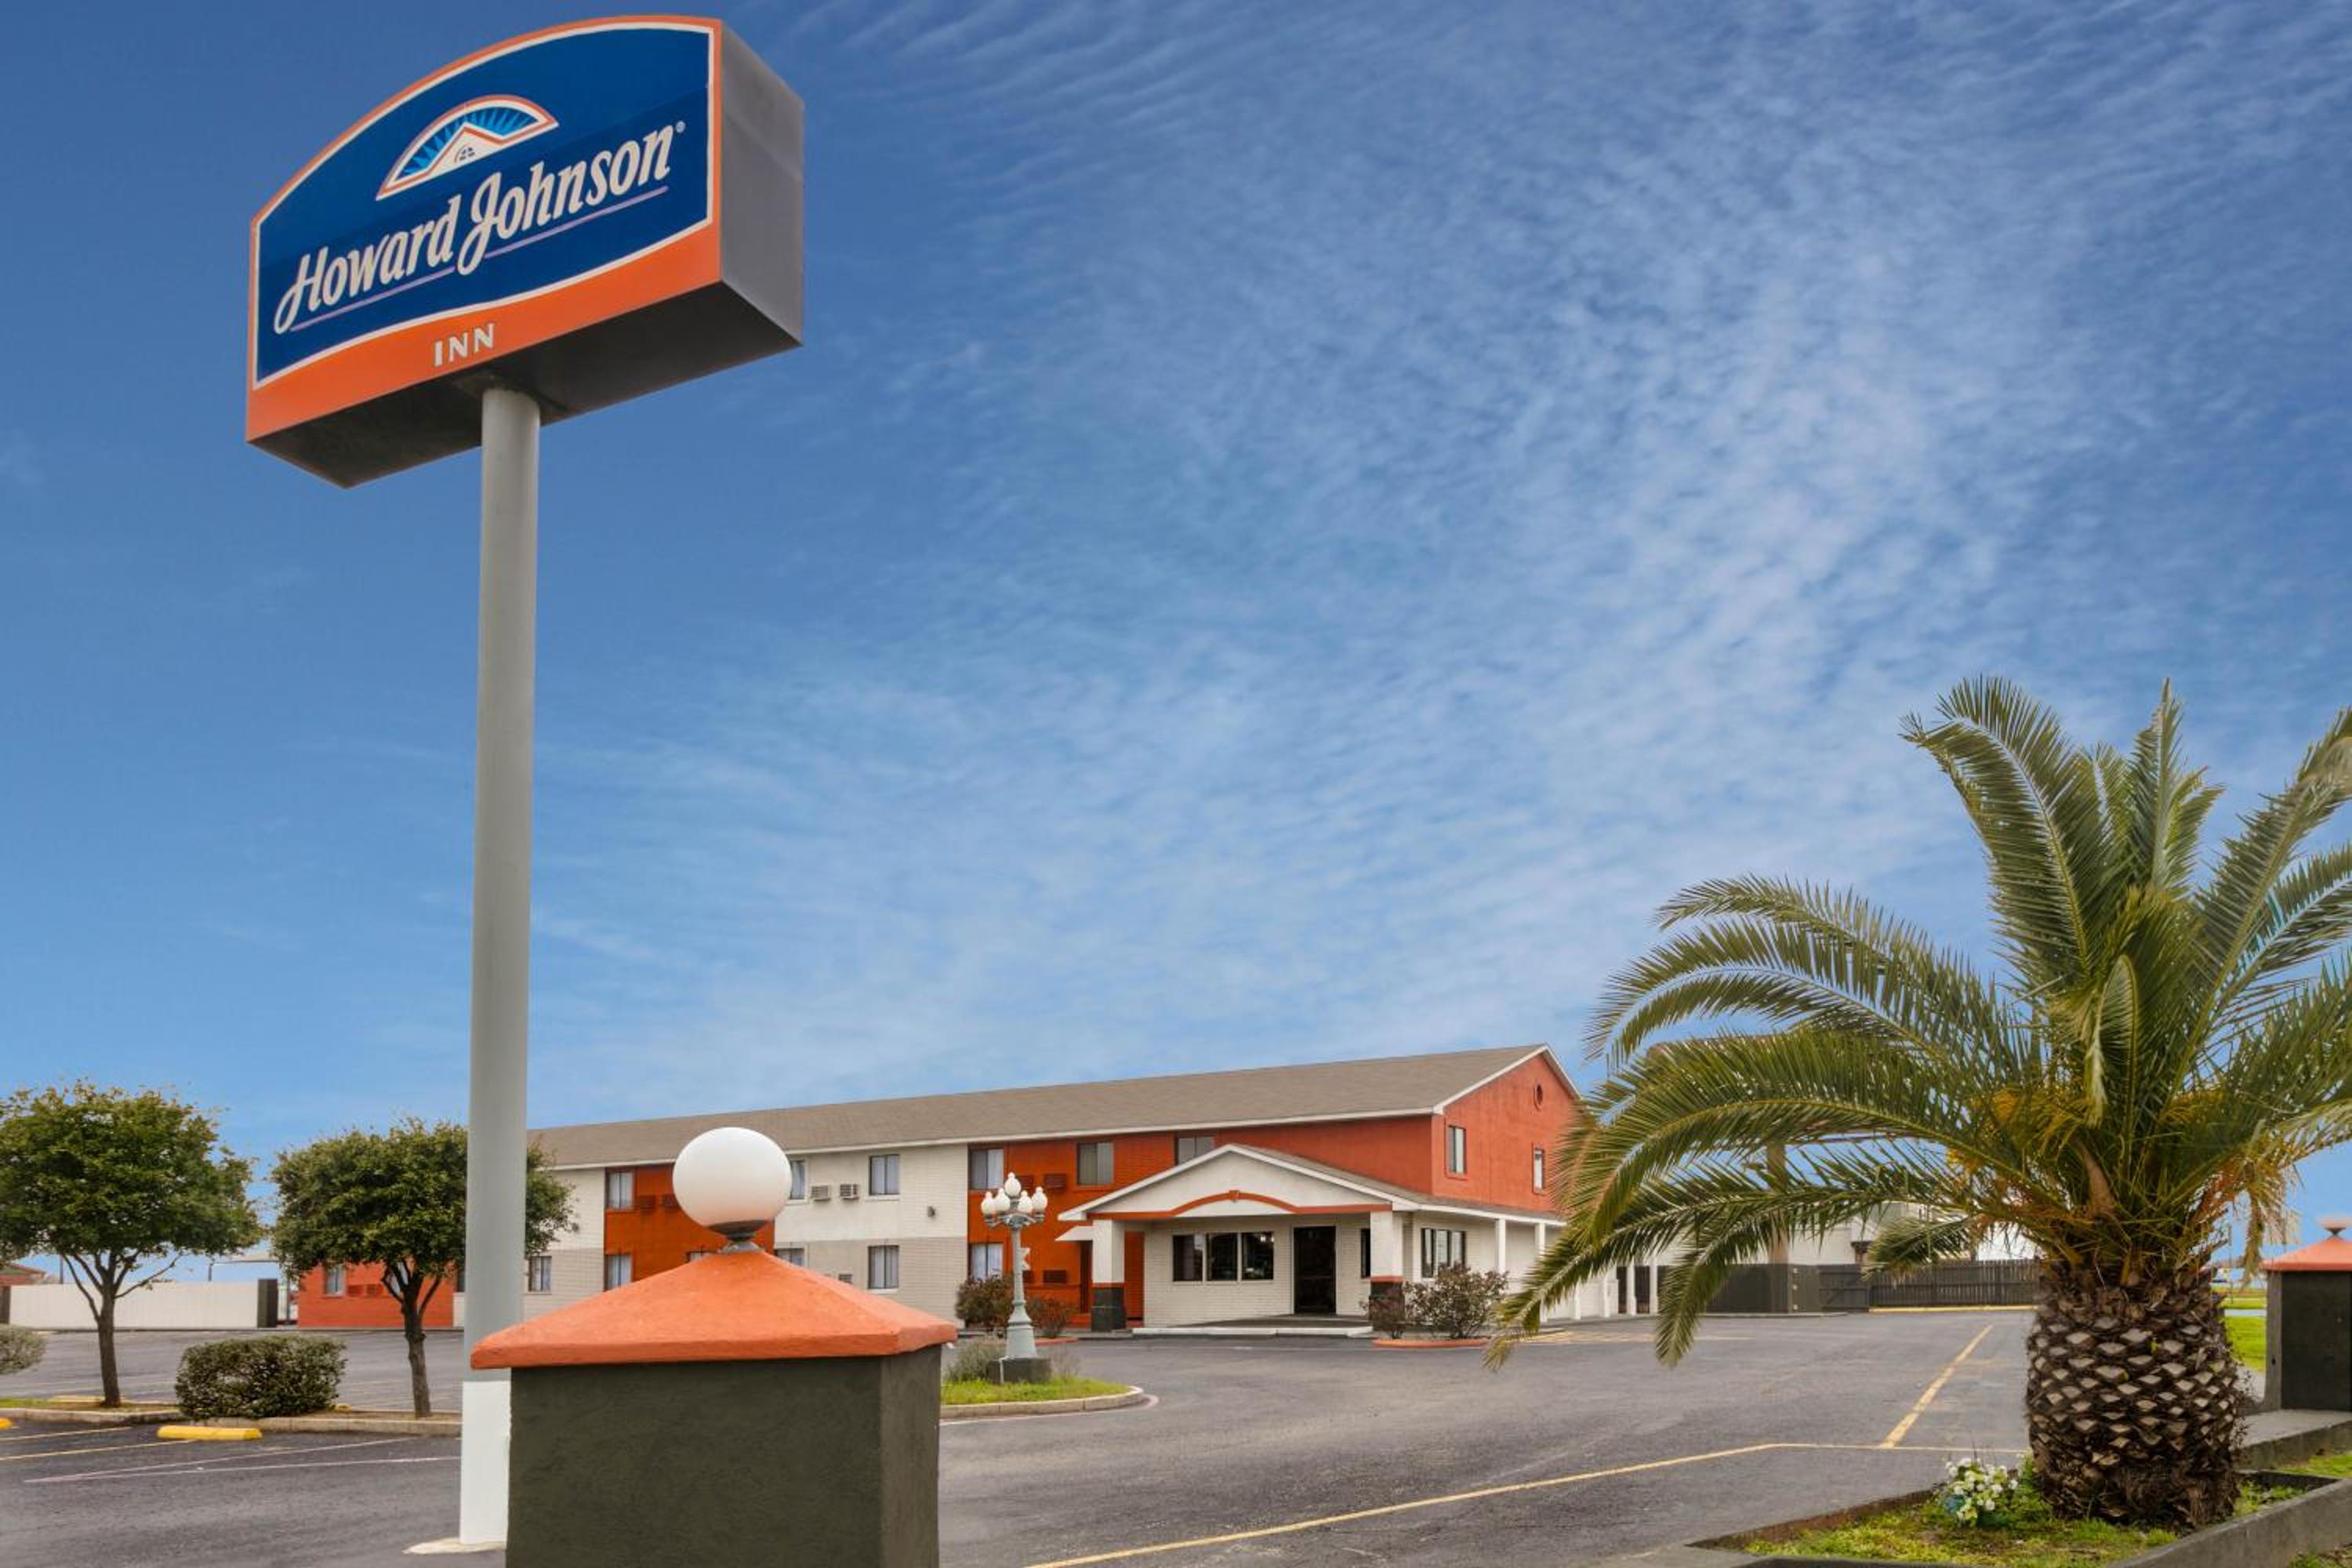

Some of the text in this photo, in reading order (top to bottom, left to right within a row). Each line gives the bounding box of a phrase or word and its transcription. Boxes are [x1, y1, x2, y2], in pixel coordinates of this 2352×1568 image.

[274, 125, 673, 335] Howard Johnson
[432, 322, 495, 368] INN
